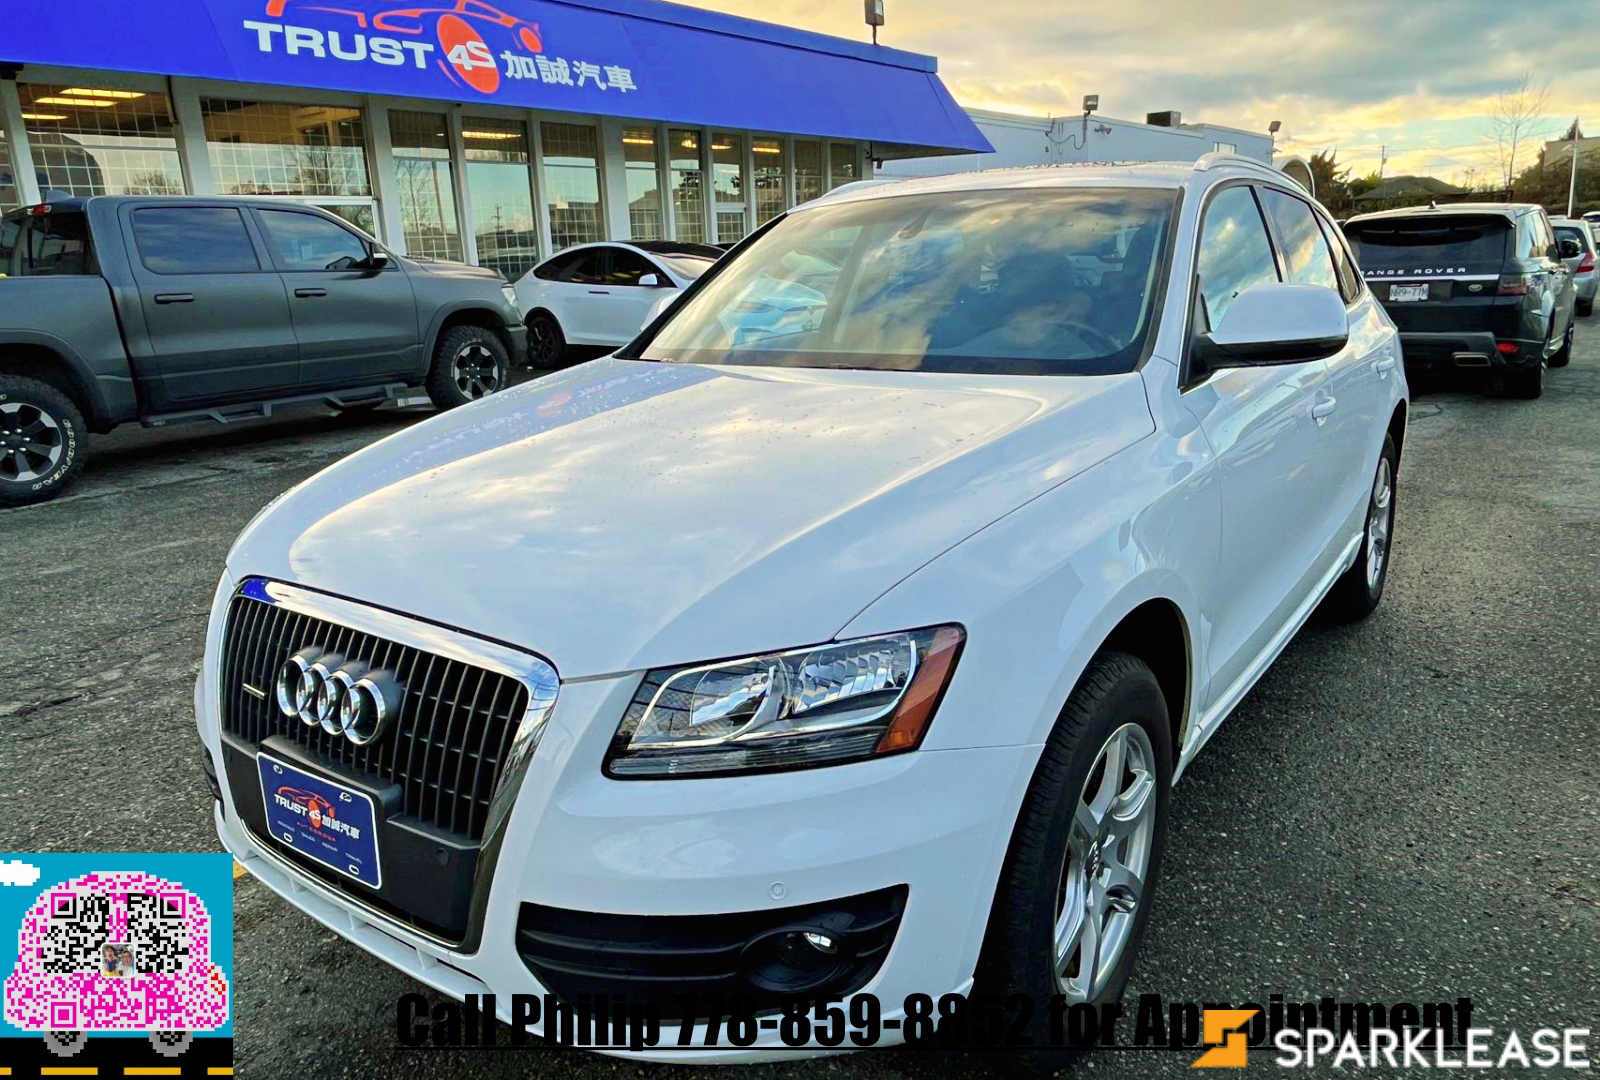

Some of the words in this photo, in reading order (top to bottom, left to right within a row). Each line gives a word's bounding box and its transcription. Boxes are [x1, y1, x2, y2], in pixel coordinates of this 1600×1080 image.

[243, 20, 434, 70] TRUST
[446, 41, 497, 71] 4S
[499, 50, 638, 93] 加誠汽車
[1413, 267, 1466, 275] ROVER
[273, 793, 309, 817] TRUST
